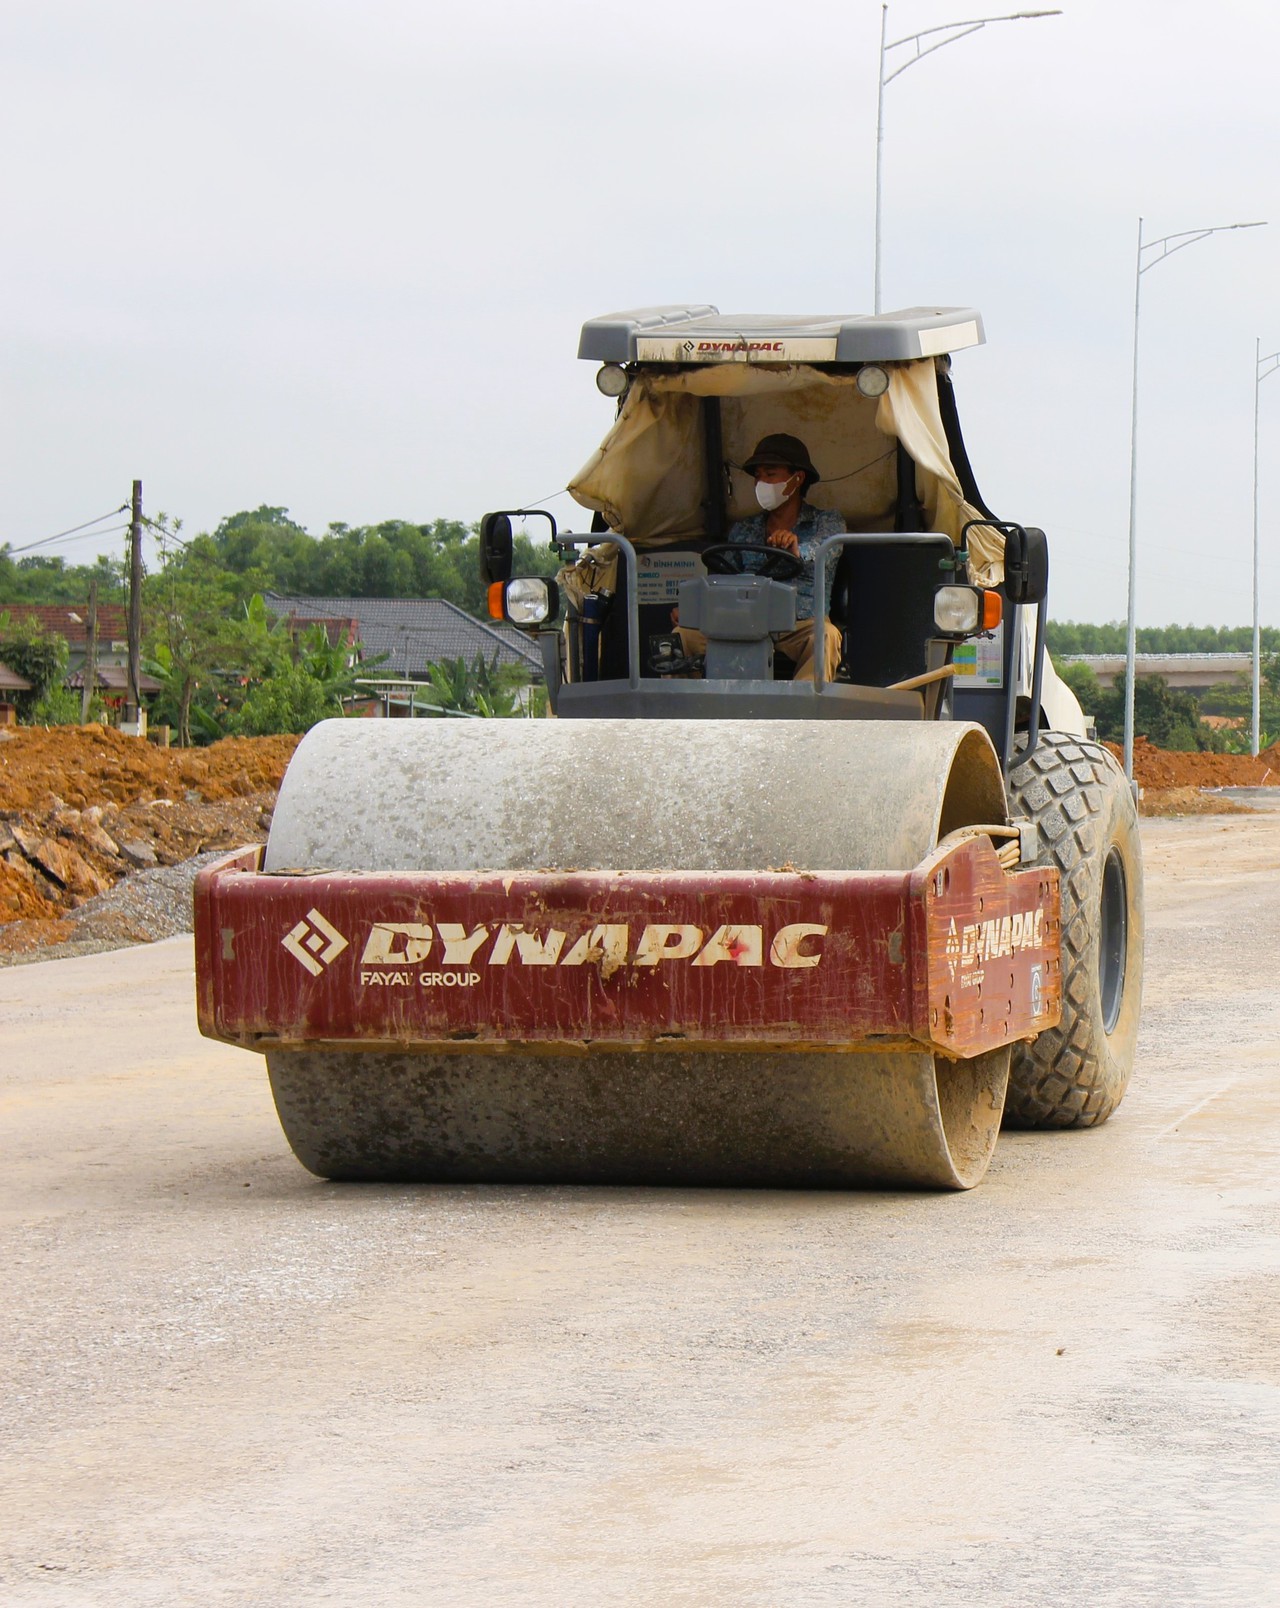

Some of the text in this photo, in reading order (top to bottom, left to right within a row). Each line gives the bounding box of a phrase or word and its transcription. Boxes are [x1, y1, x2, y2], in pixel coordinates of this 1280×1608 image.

[697, 342, 783, 351] DYNAPAC
[360, 922, 829, 969] DYNAPAC
[961, 908, 1044, 968] DYNAPAC
[419, 972, 481, 987] GROUP
